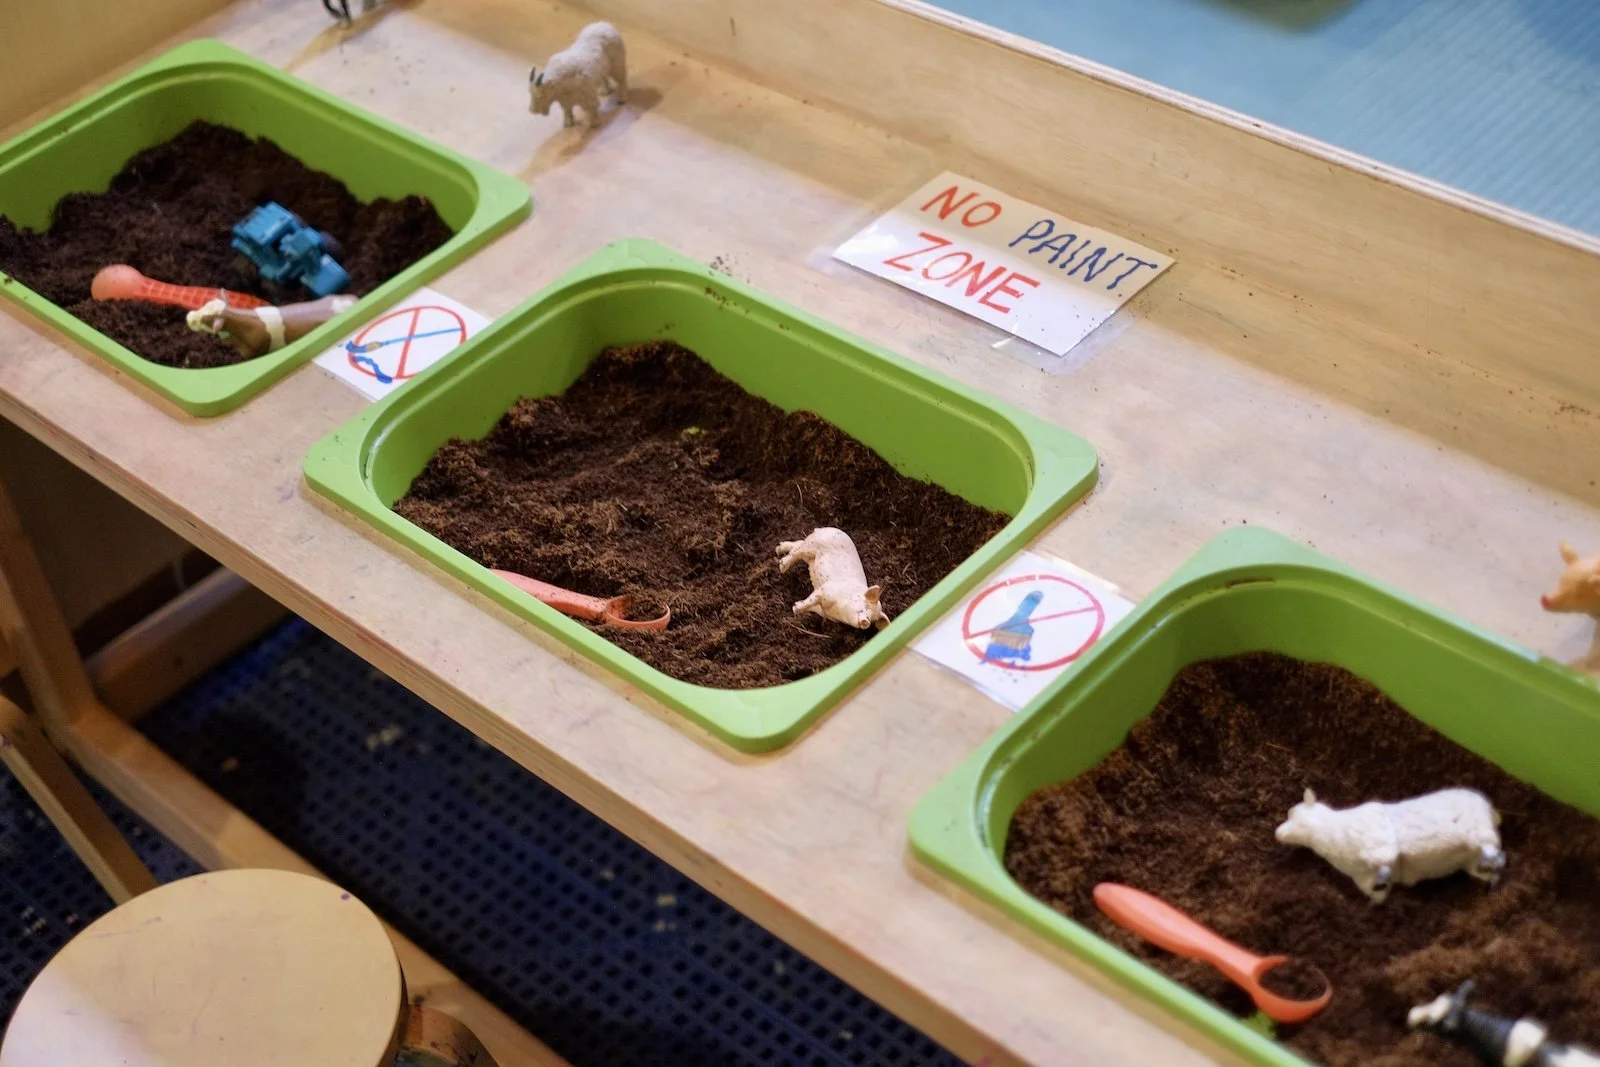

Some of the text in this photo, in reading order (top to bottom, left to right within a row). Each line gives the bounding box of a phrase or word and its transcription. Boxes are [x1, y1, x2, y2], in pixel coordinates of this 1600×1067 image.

[883, 231, 1040, 314] ZONE
[920, 185, 1158, 290] NO PAINT
